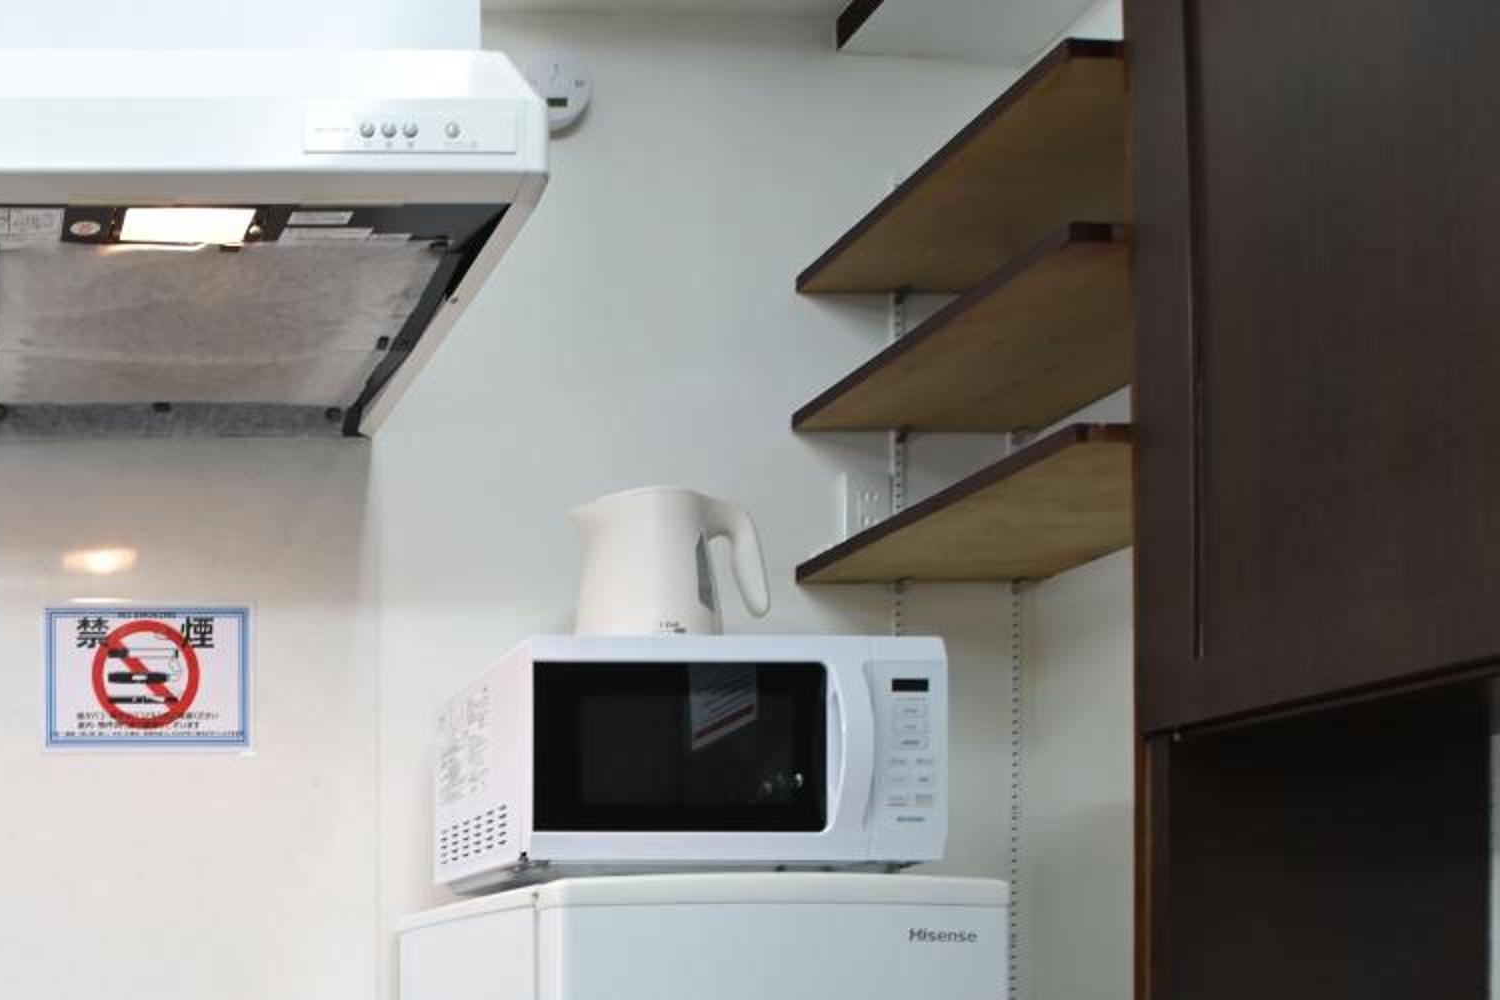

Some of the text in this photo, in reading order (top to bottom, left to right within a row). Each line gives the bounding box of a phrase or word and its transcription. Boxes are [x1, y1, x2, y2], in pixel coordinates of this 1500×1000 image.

[76, 616, 215, 649] 禁 煙
[908, 928, 978, 943] Hisense
